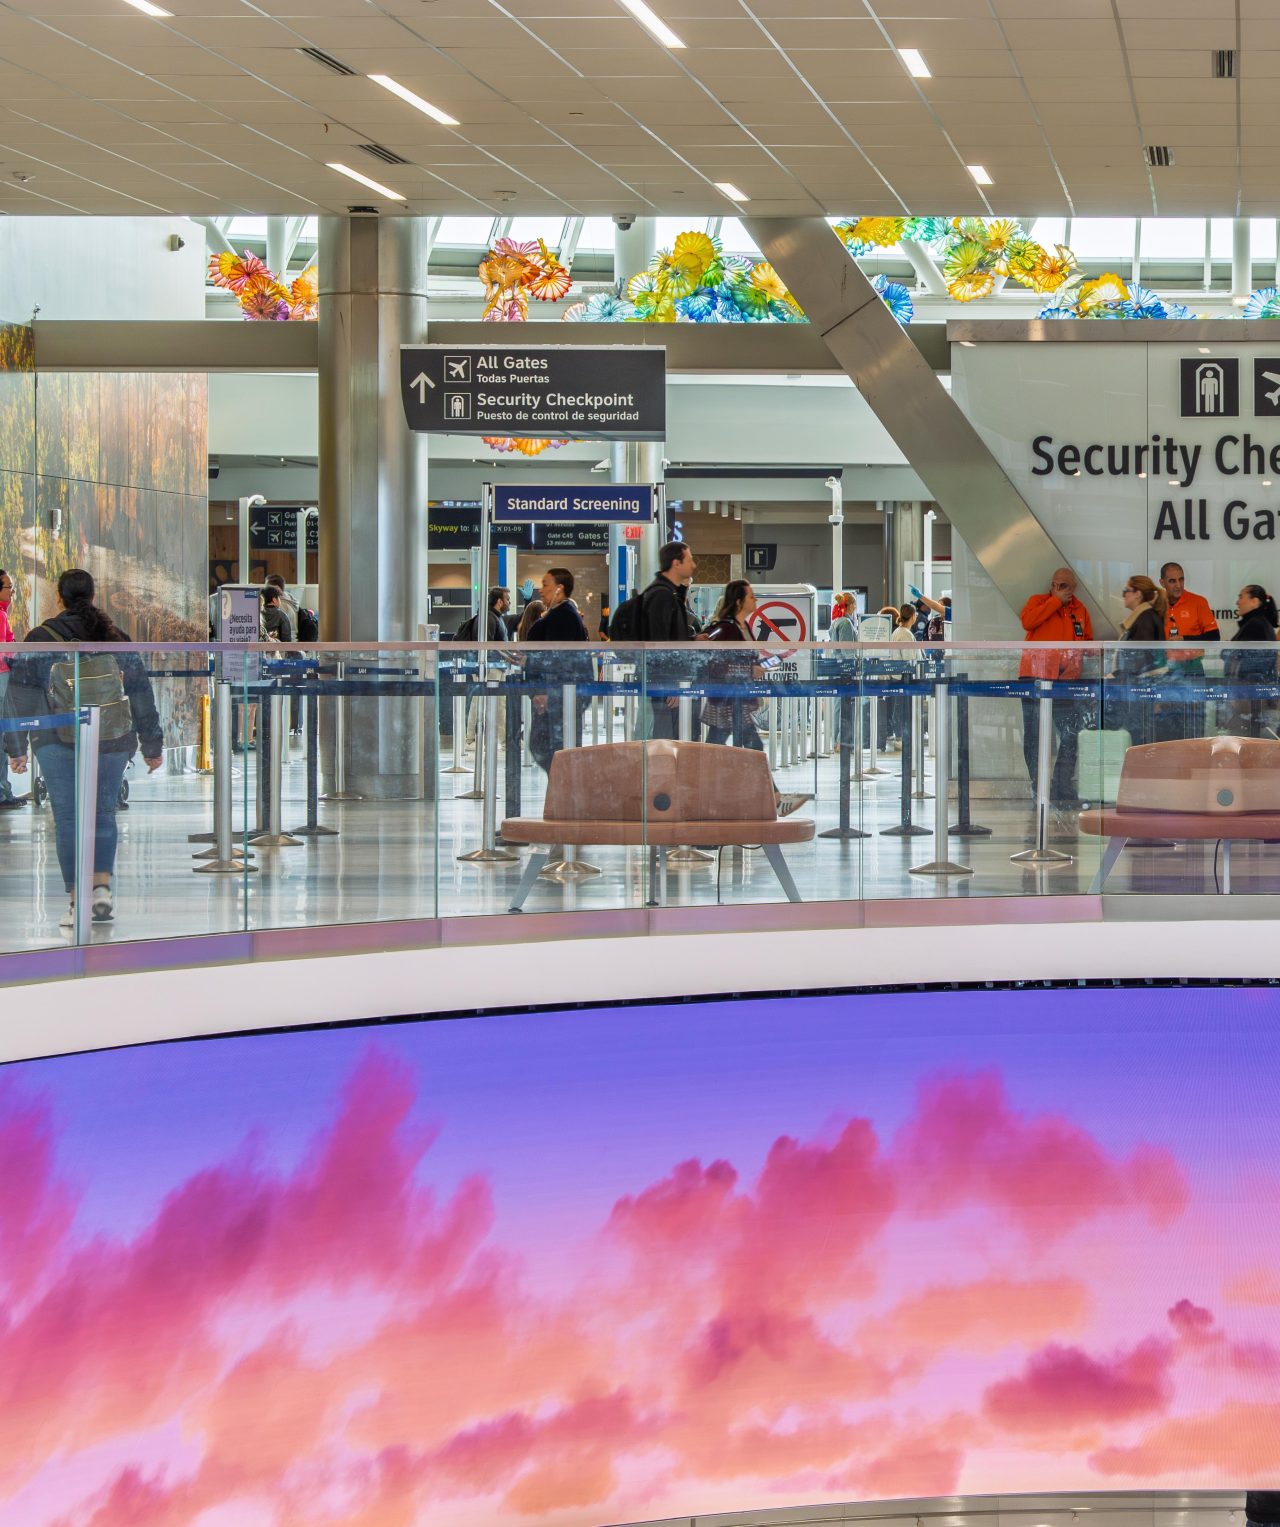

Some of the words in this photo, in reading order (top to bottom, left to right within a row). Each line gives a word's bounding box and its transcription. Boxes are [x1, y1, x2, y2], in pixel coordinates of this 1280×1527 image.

[477, 356, 498, 369] All
[504, 356, 548, 369] Gates
[477, 374, 506, 383] Todas
[510, 374, 550, 383] Puertas
[477, 393, 540, 410] Security
[546, 393, 634, 410] Checkpoint
[477, 412, 512, 420] Puesto
[516, 411, 528, 420] de
[532, 411, 568, 420] control
[572, 411, 584, 420] de
[588, 411, 639, 422] seguridad
[1032, 434, 1202, 488] Security
[508, 498, 568, 510] Standard
[573, 498, 640, 514] Screening
[1154, 499, 1210, 541] All
[428, 524, 458, 533] Skyway
[626, 526, 641, 538] EXIT
[246, 627, 257, 635] para
